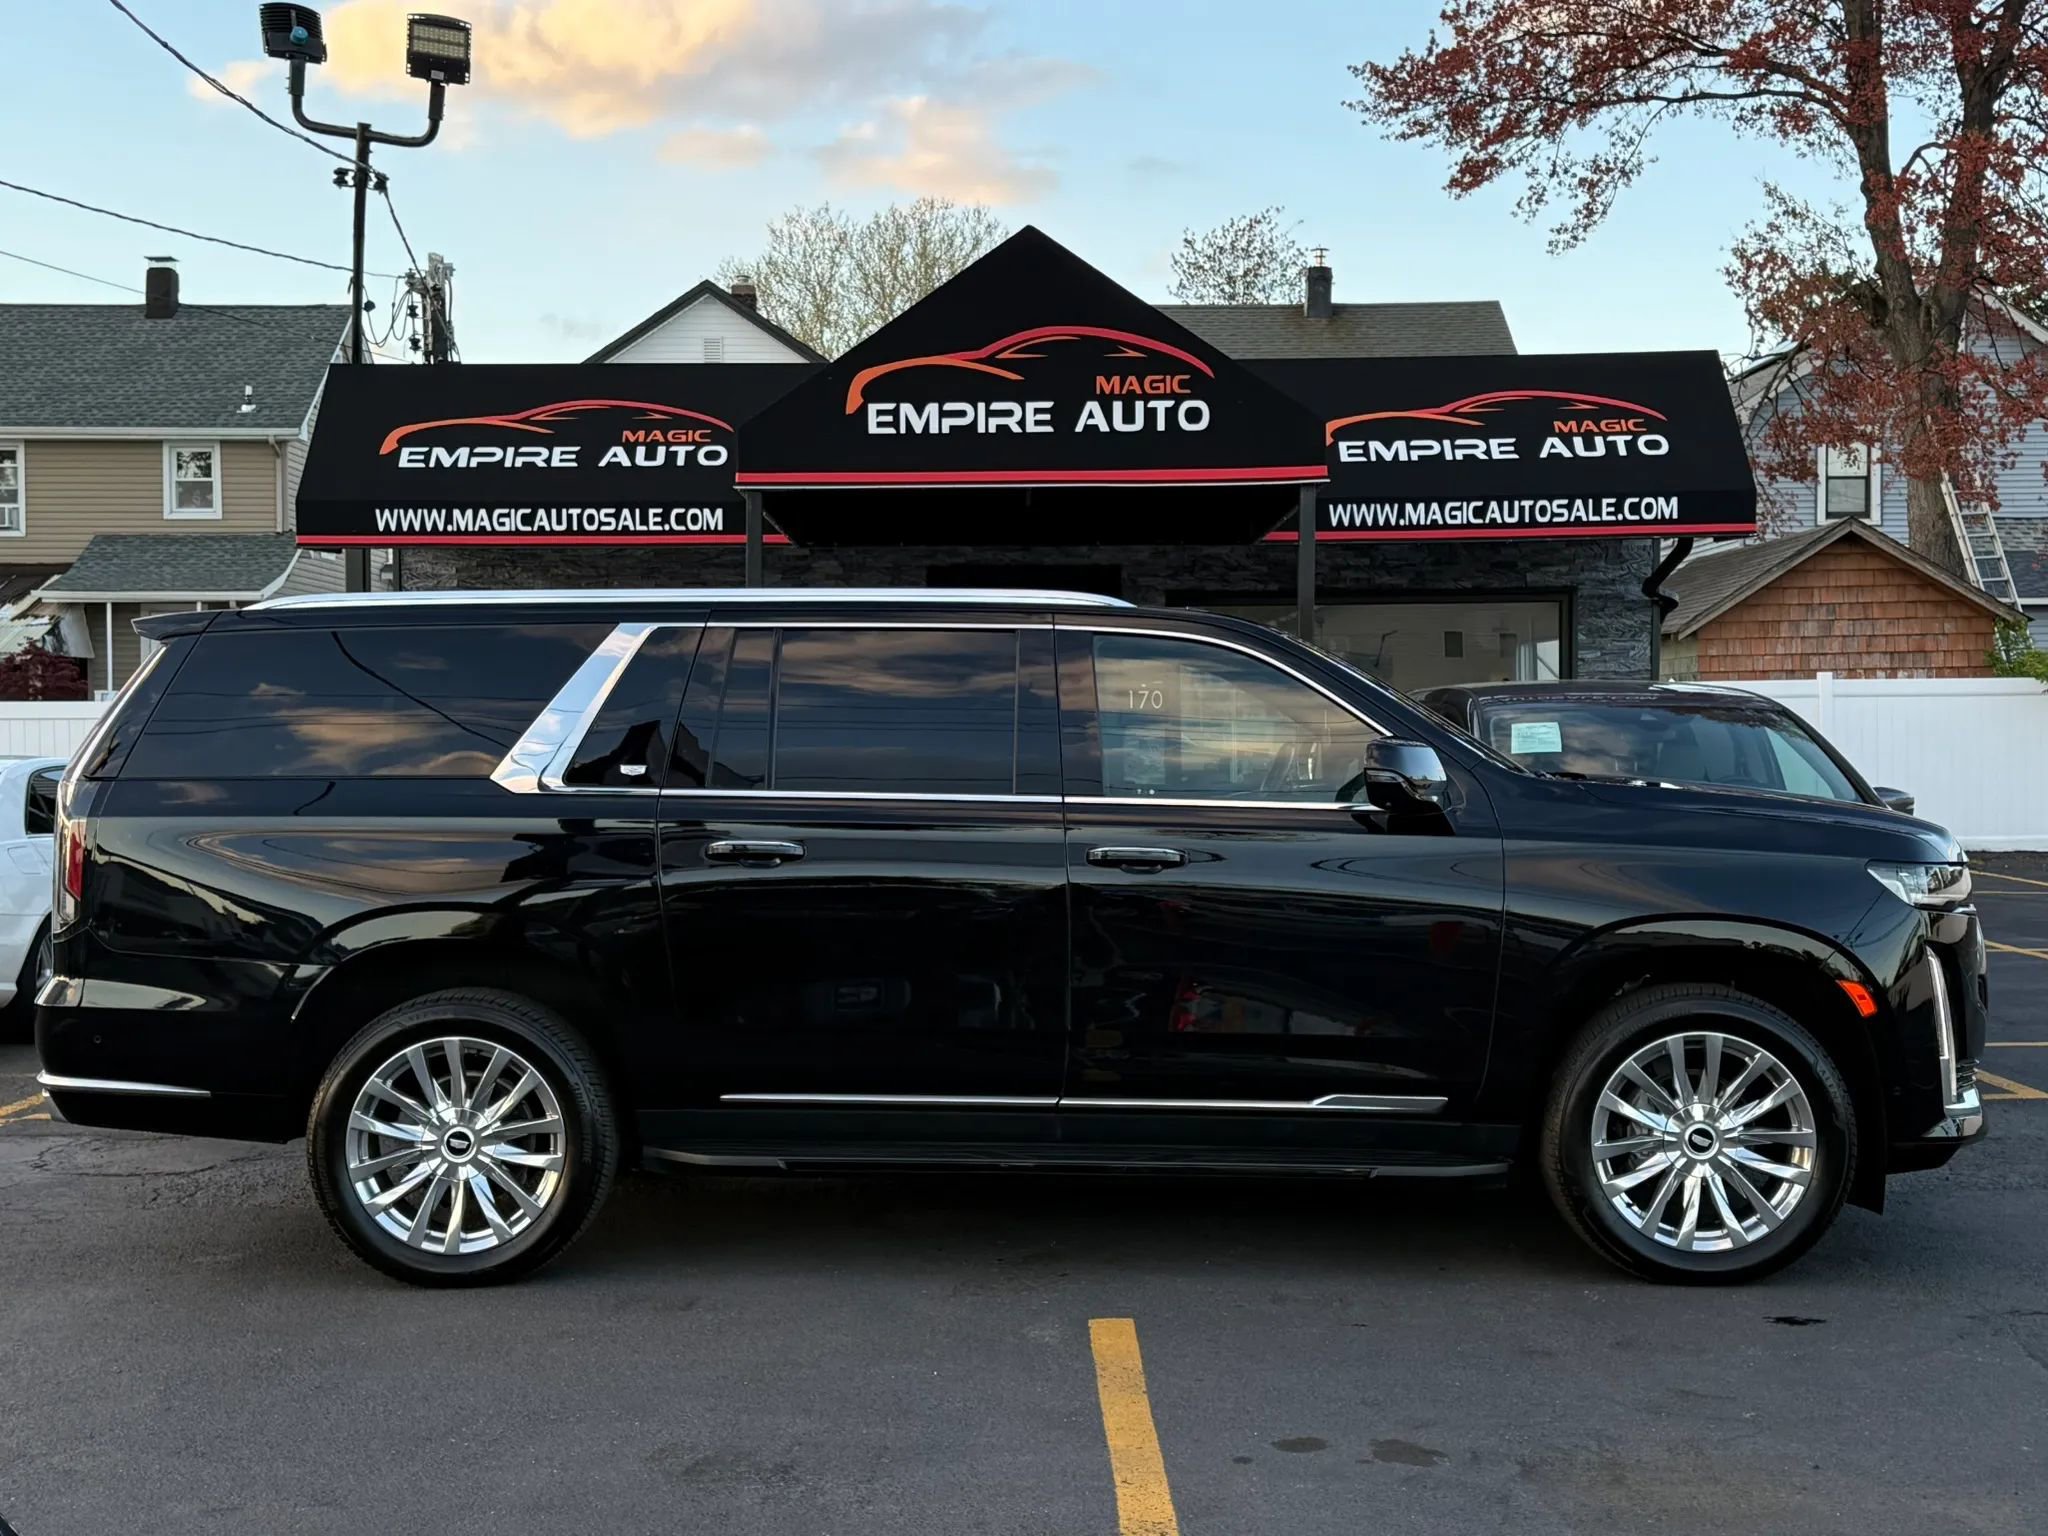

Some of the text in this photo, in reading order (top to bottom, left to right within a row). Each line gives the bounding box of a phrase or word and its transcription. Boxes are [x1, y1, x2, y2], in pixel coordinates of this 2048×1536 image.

[1095, 375, 1192, 395] MAGIC
[868, 400, 1210, 434] EMPIRE AUTO
[1553, 418, 1647, 433] MAGIC
[622, 430, 712, 443] MAGIC
[1338, 433, 1669, 462] EMPIRE AUTO
[398, 445, 728, 468] EMPIRE AUTO
[375, 508, 723, 532] WWW.MAGICAUTOSALE.COM
[1329, 497, 1678, 526] WWW.MAGICAUTOSALE.COM
